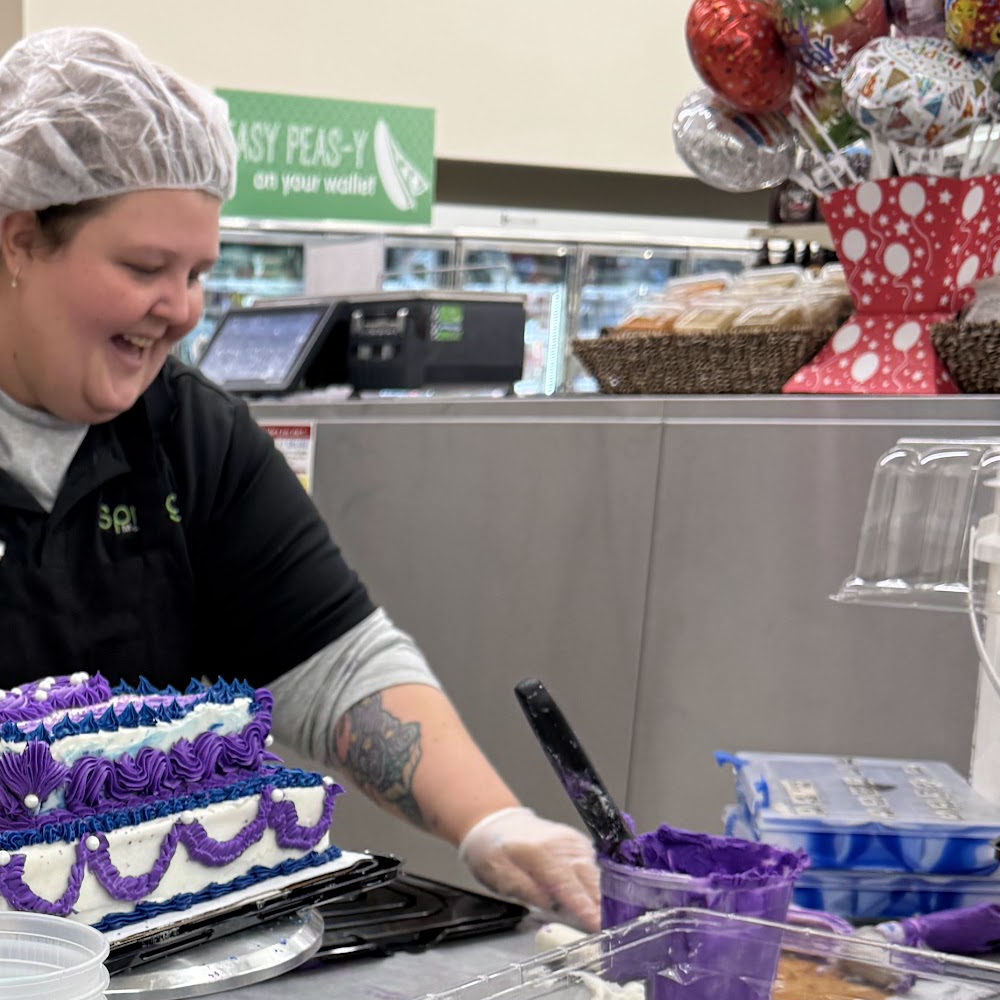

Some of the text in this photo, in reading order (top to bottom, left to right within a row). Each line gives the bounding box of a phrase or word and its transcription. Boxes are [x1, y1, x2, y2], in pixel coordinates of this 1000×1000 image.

[231, 119, 369, 169] ASY PEAS-Y
[253, 171, 377, 197] on your wallet
